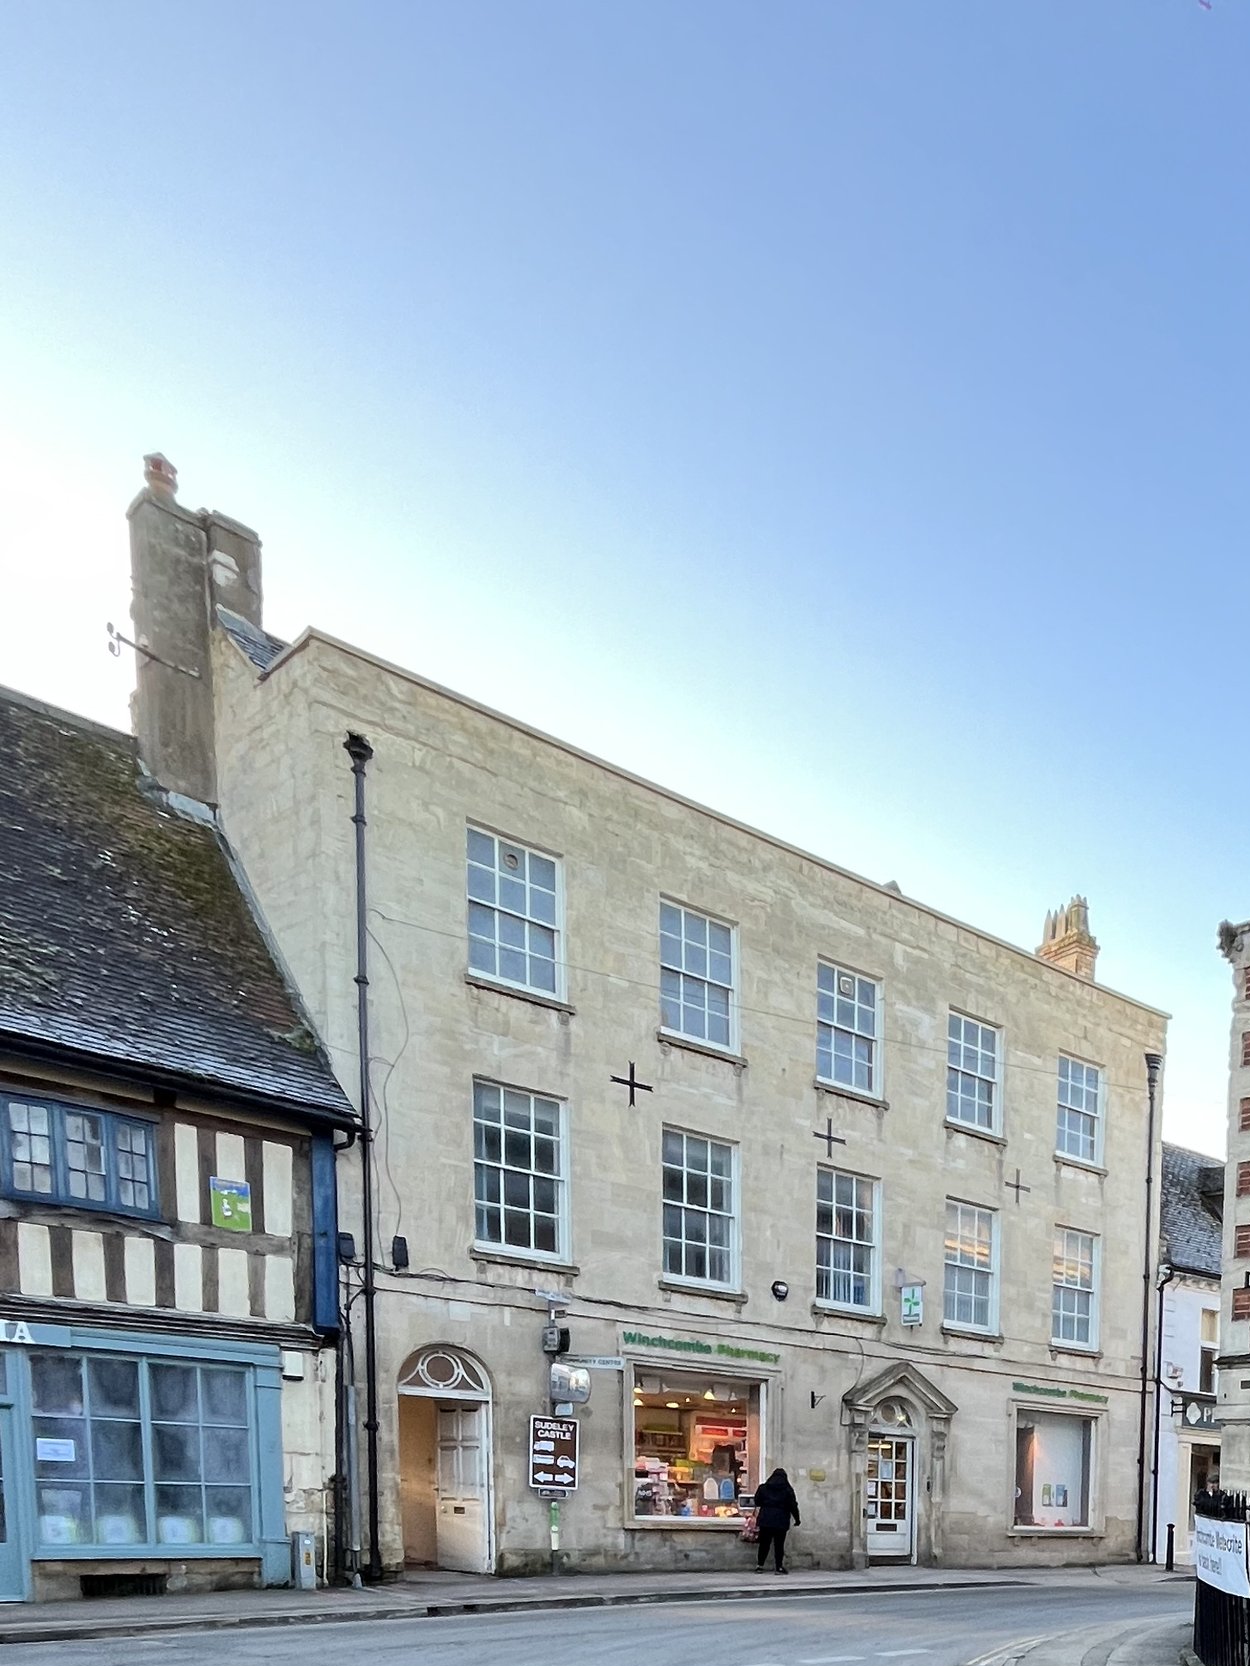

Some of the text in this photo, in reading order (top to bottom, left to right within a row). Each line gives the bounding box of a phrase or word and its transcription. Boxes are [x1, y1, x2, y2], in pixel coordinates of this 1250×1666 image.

[623, 1331, 781, 1364] Winchcombe Pharmacy
[534, 1421, 575, 1432] SUDELEY
[537, 1430, 572, 1440] CASTLE
